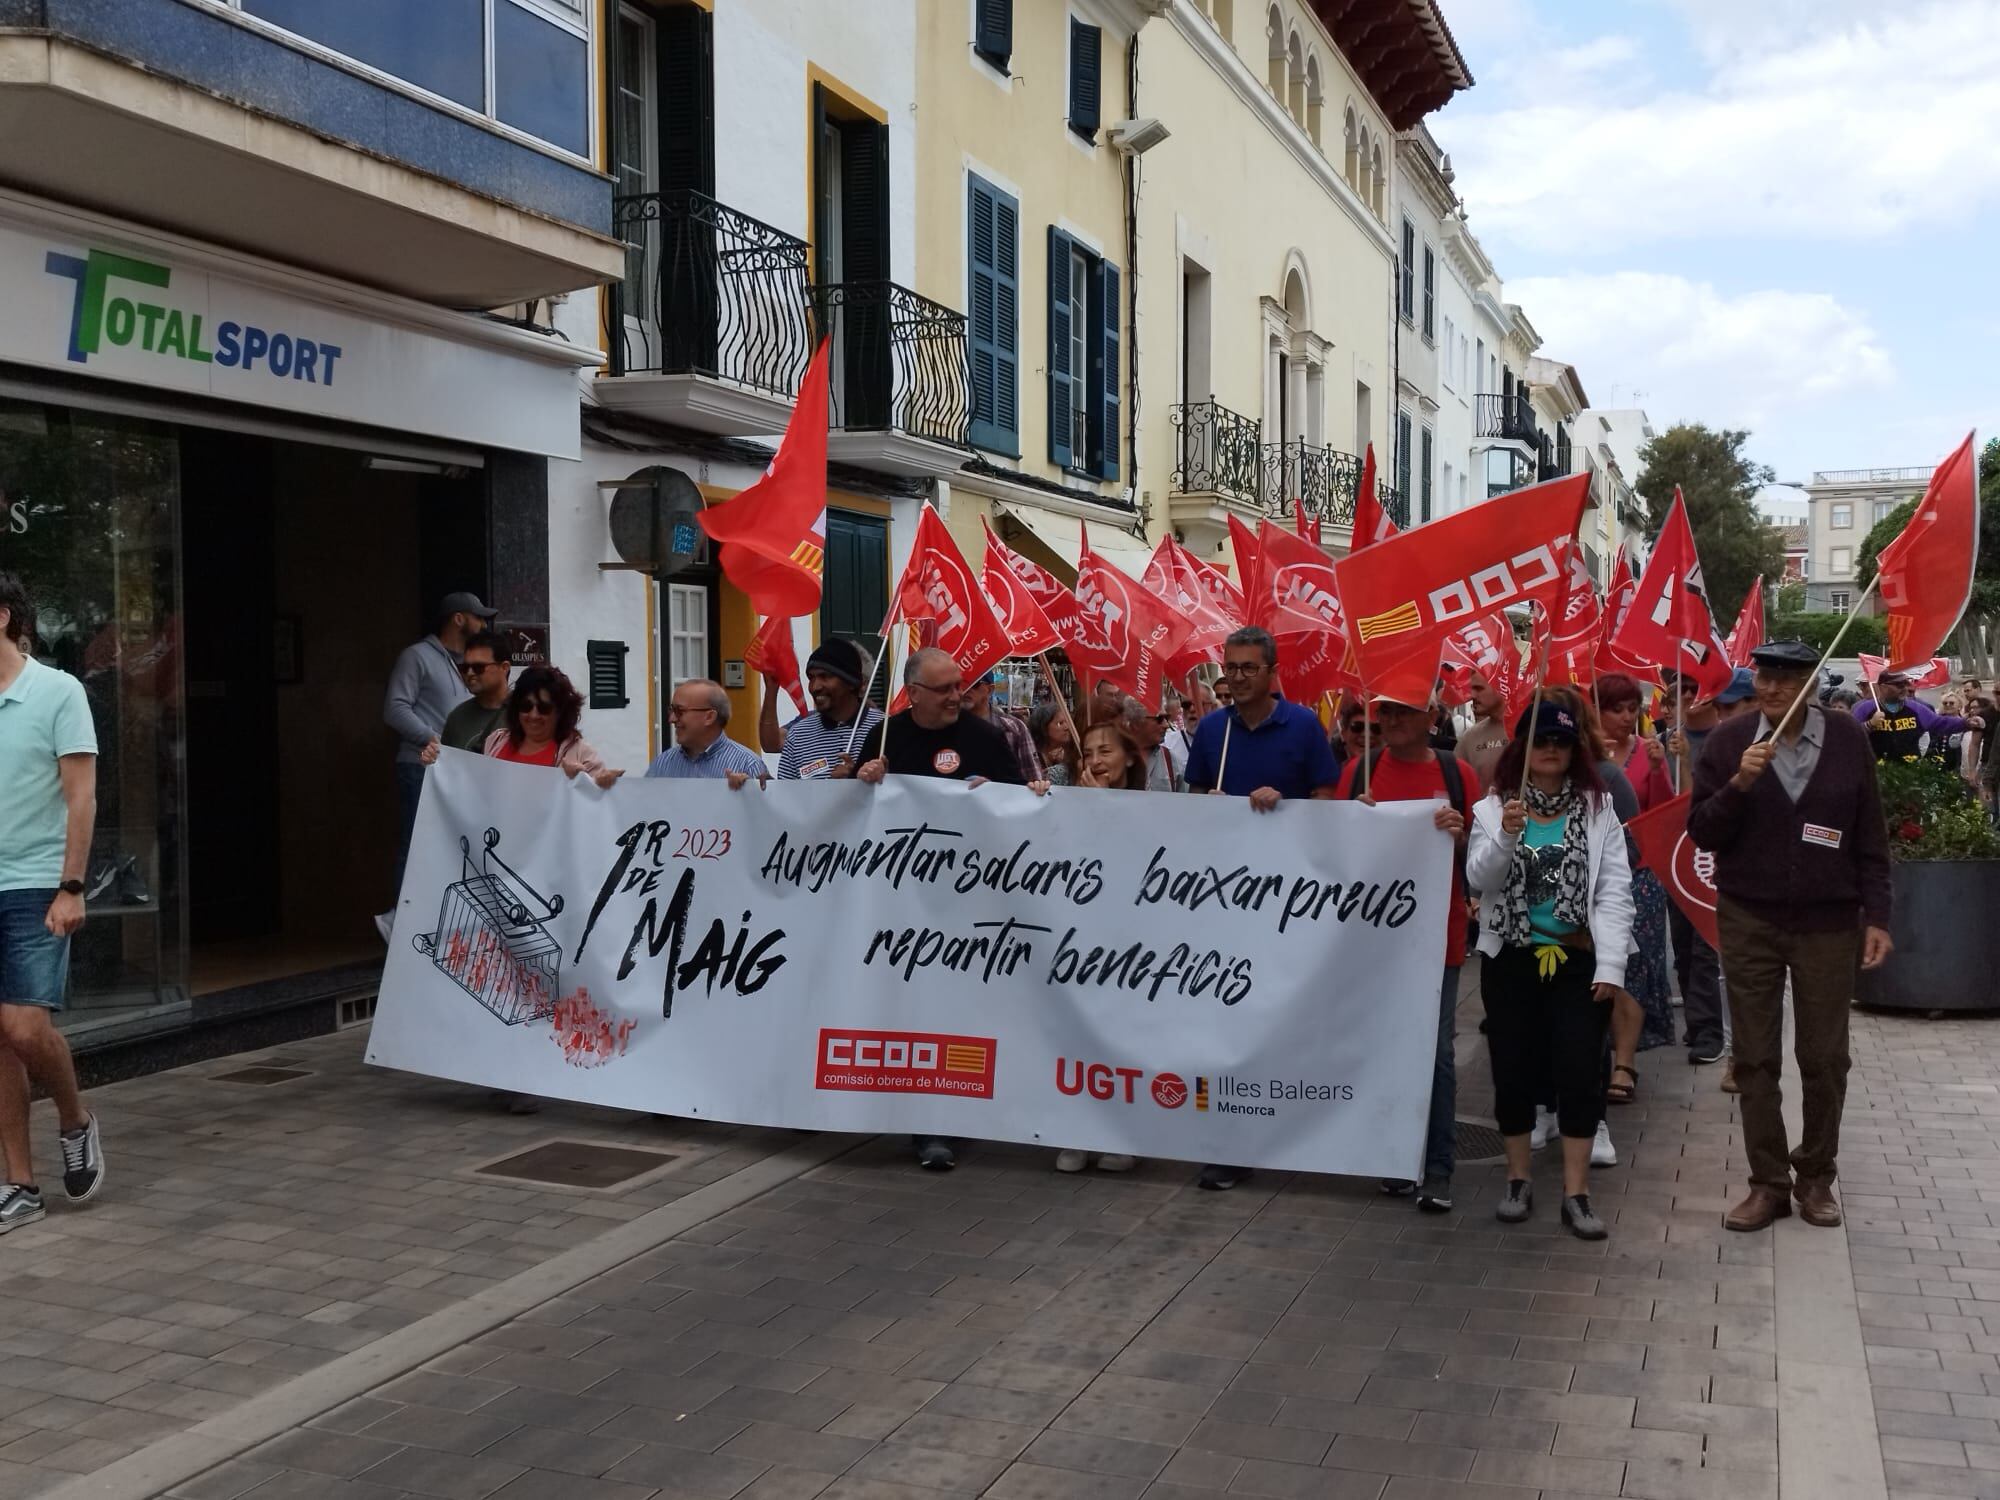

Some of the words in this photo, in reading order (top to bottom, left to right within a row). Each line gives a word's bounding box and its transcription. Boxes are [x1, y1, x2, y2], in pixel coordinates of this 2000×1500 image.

[672, 828, 732, 861] 2023
[620, 867, 665, 898] DE
[954, 840, 1103, 905] salaris
[1134, 846, 1284, 912] baixar
[1278, 879, 1417, 933] preus
[863, 917, 1052, 984] repartir
[1047, 927, 1252, 1006] beneficis
[827, 1038, 938, 1069] CCOO
[824, 1073, 874, 1086] comissió
[877, 1075, 913, 1087] obrera
[916, 1075, 932, 1088] de
[935, 1076, 985, 1092] Menorca
[1056, 1057, 1143, 1104] UGT
[1218, 1075, 1262, 1098] Illes
[1269, 1079, 1354, 1101] Balears
[1217, 1101, 1276, 1117] Menorca
